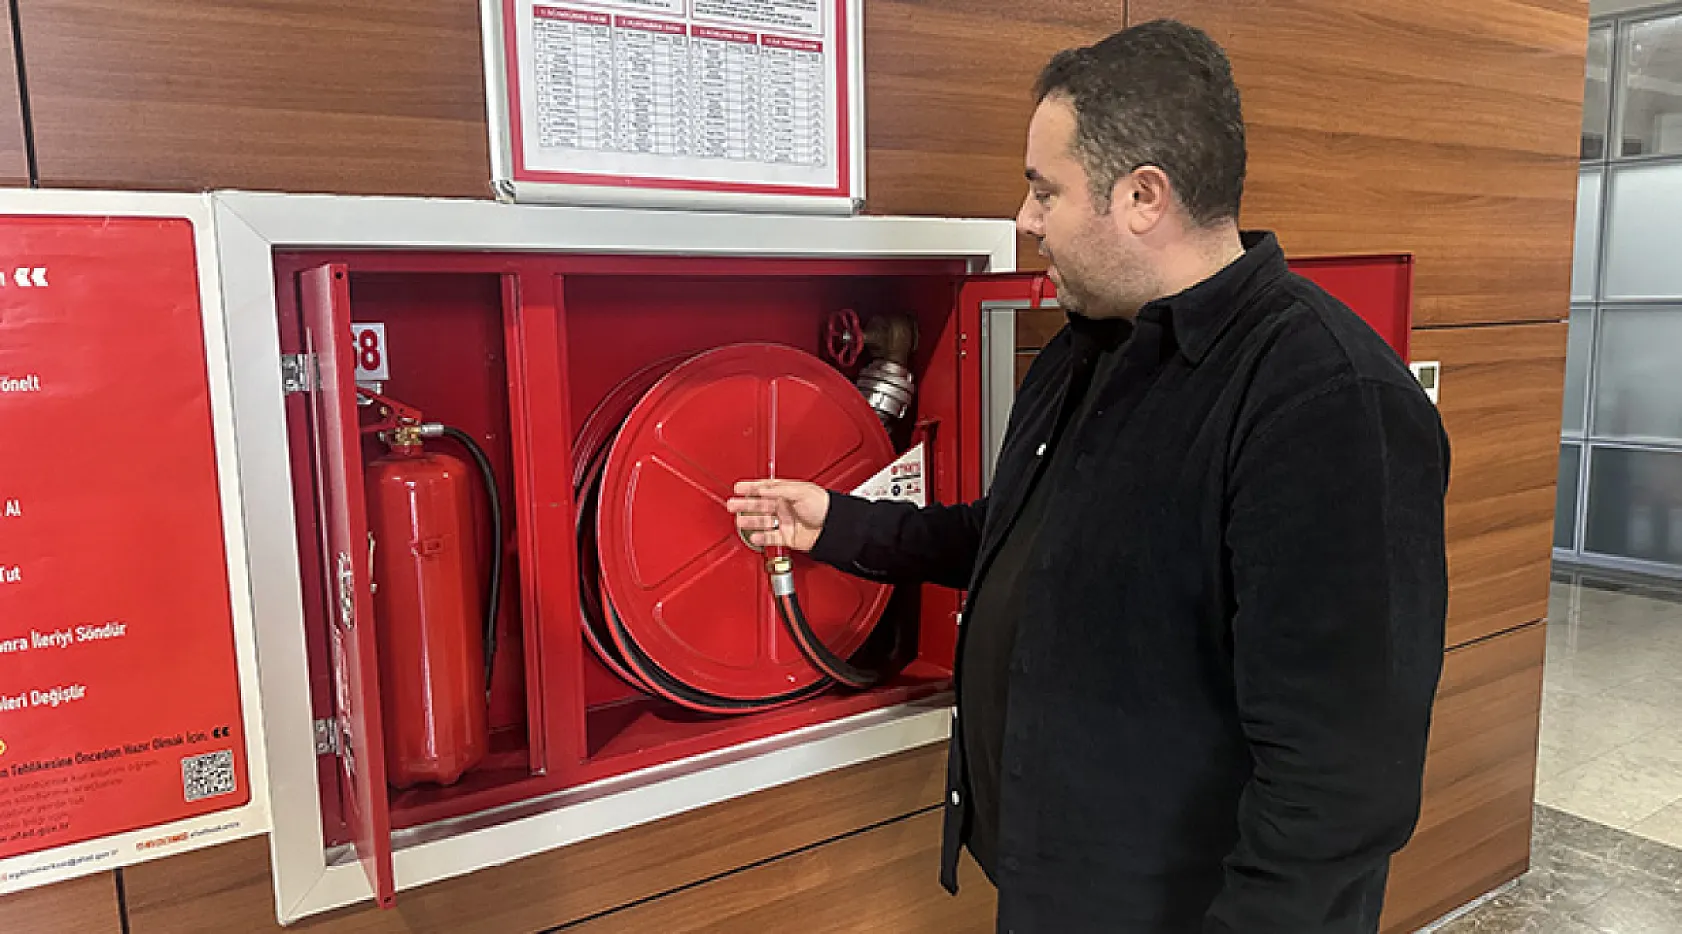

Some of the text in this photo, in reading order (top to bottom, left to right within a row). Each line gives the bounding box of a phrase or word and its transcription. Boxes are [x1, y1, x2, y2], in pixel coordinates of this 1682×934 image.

[31, 628, 73, 649] İleriyi
[75, 622, 126, 643] Söndür
[30, 683, 87, 708] Değiştir
